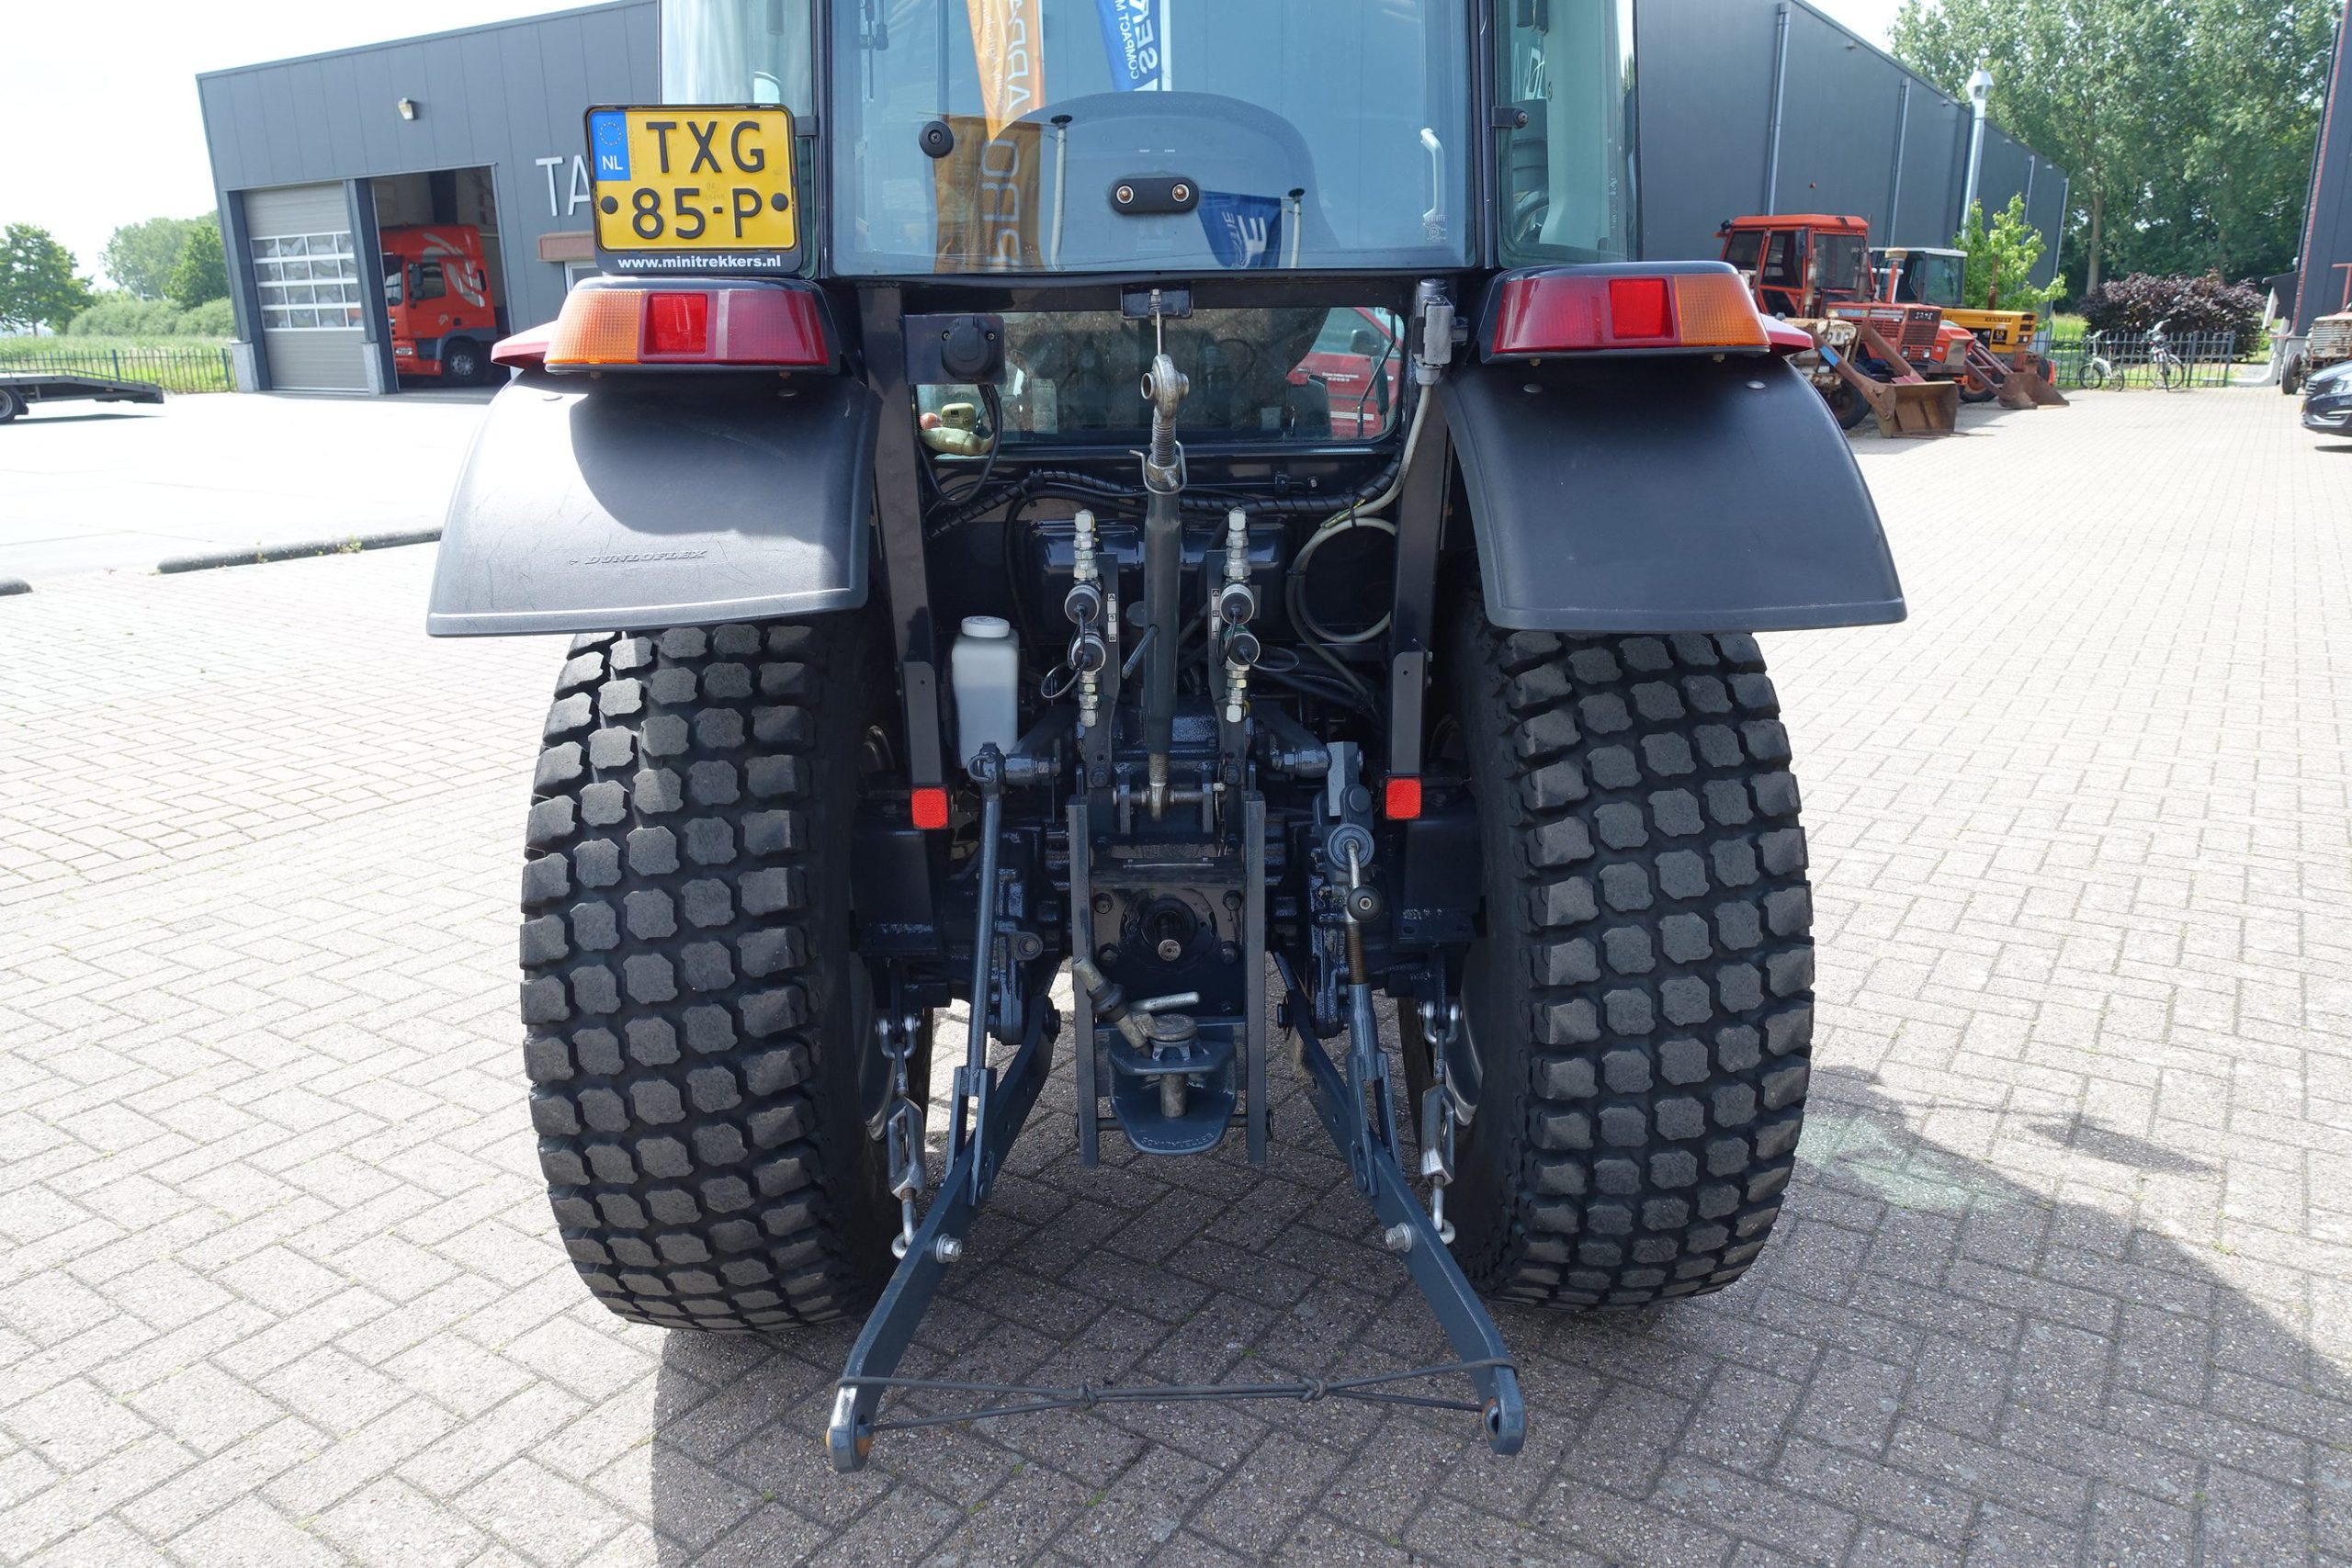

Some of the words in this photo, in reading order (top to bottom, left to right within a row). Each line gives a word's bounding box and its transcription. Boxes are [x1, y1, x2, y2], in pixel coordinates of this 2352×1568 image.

[602, 154, 624, 171] NL
[646, 121, 765, 174] TXG
[632, 187, 763, 240] 85-P
[617, 254, 781, 269] www.minitrekkers.nl
